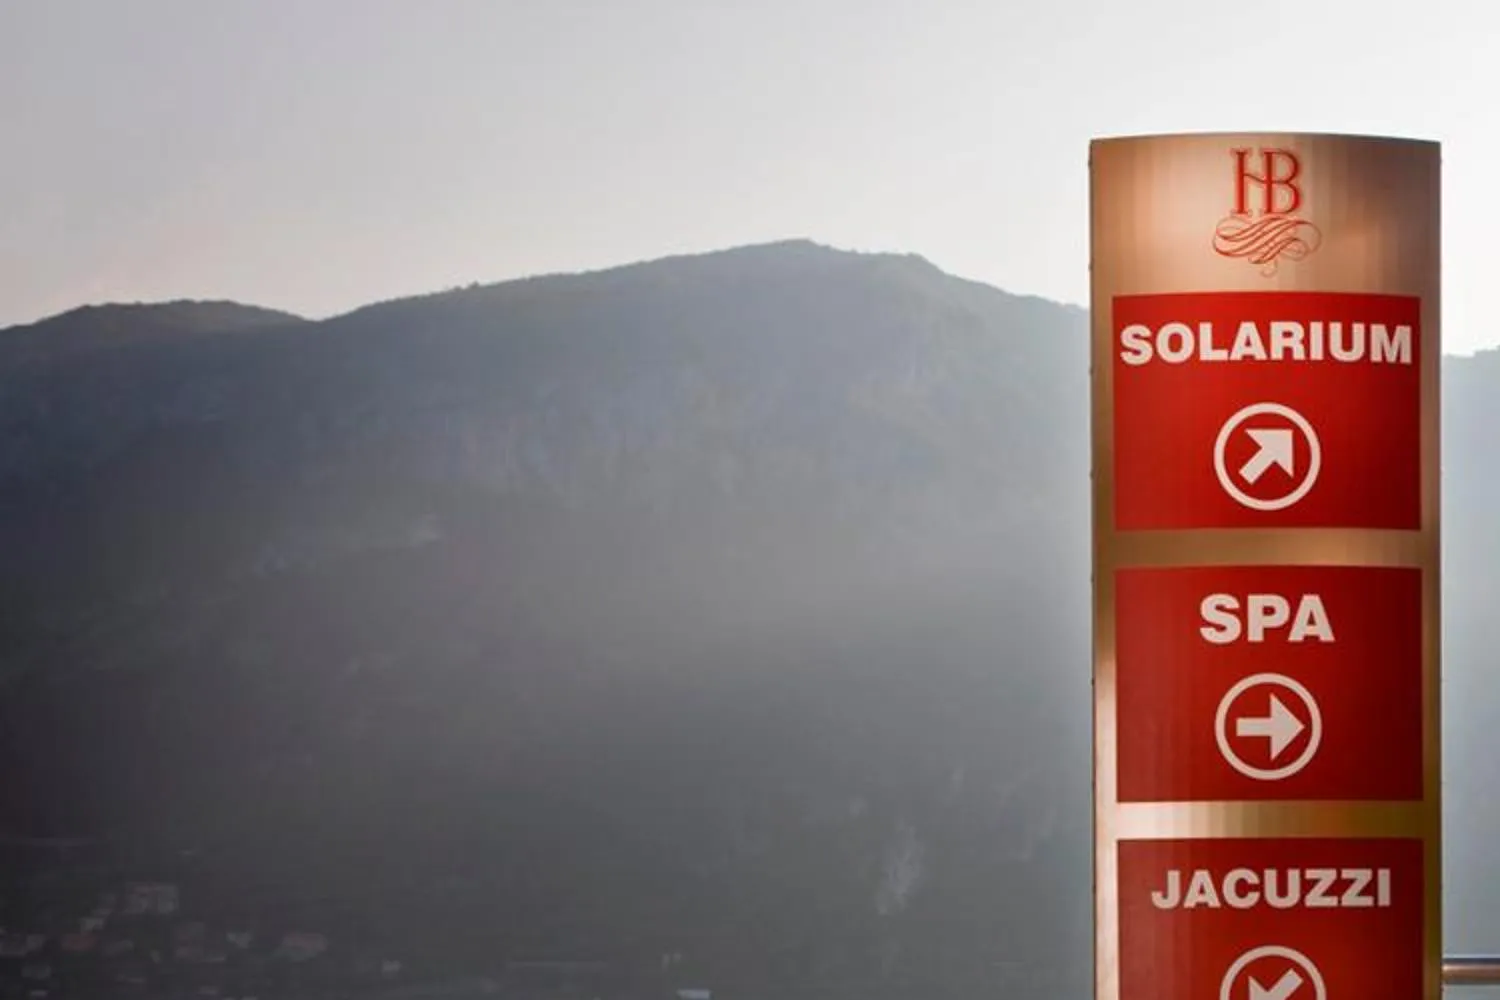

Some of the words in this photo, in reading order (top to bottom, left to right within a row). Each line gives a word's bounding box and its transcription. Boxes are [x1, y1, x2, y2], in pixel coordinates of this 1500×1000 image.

[1231, 149, 1303, 216] HB
[1120, 321, 1412, 365] SOLARIUM
[1200, 593, 1335, 644] SPA
[1152, 868, 1392, 909] JACUZZI
